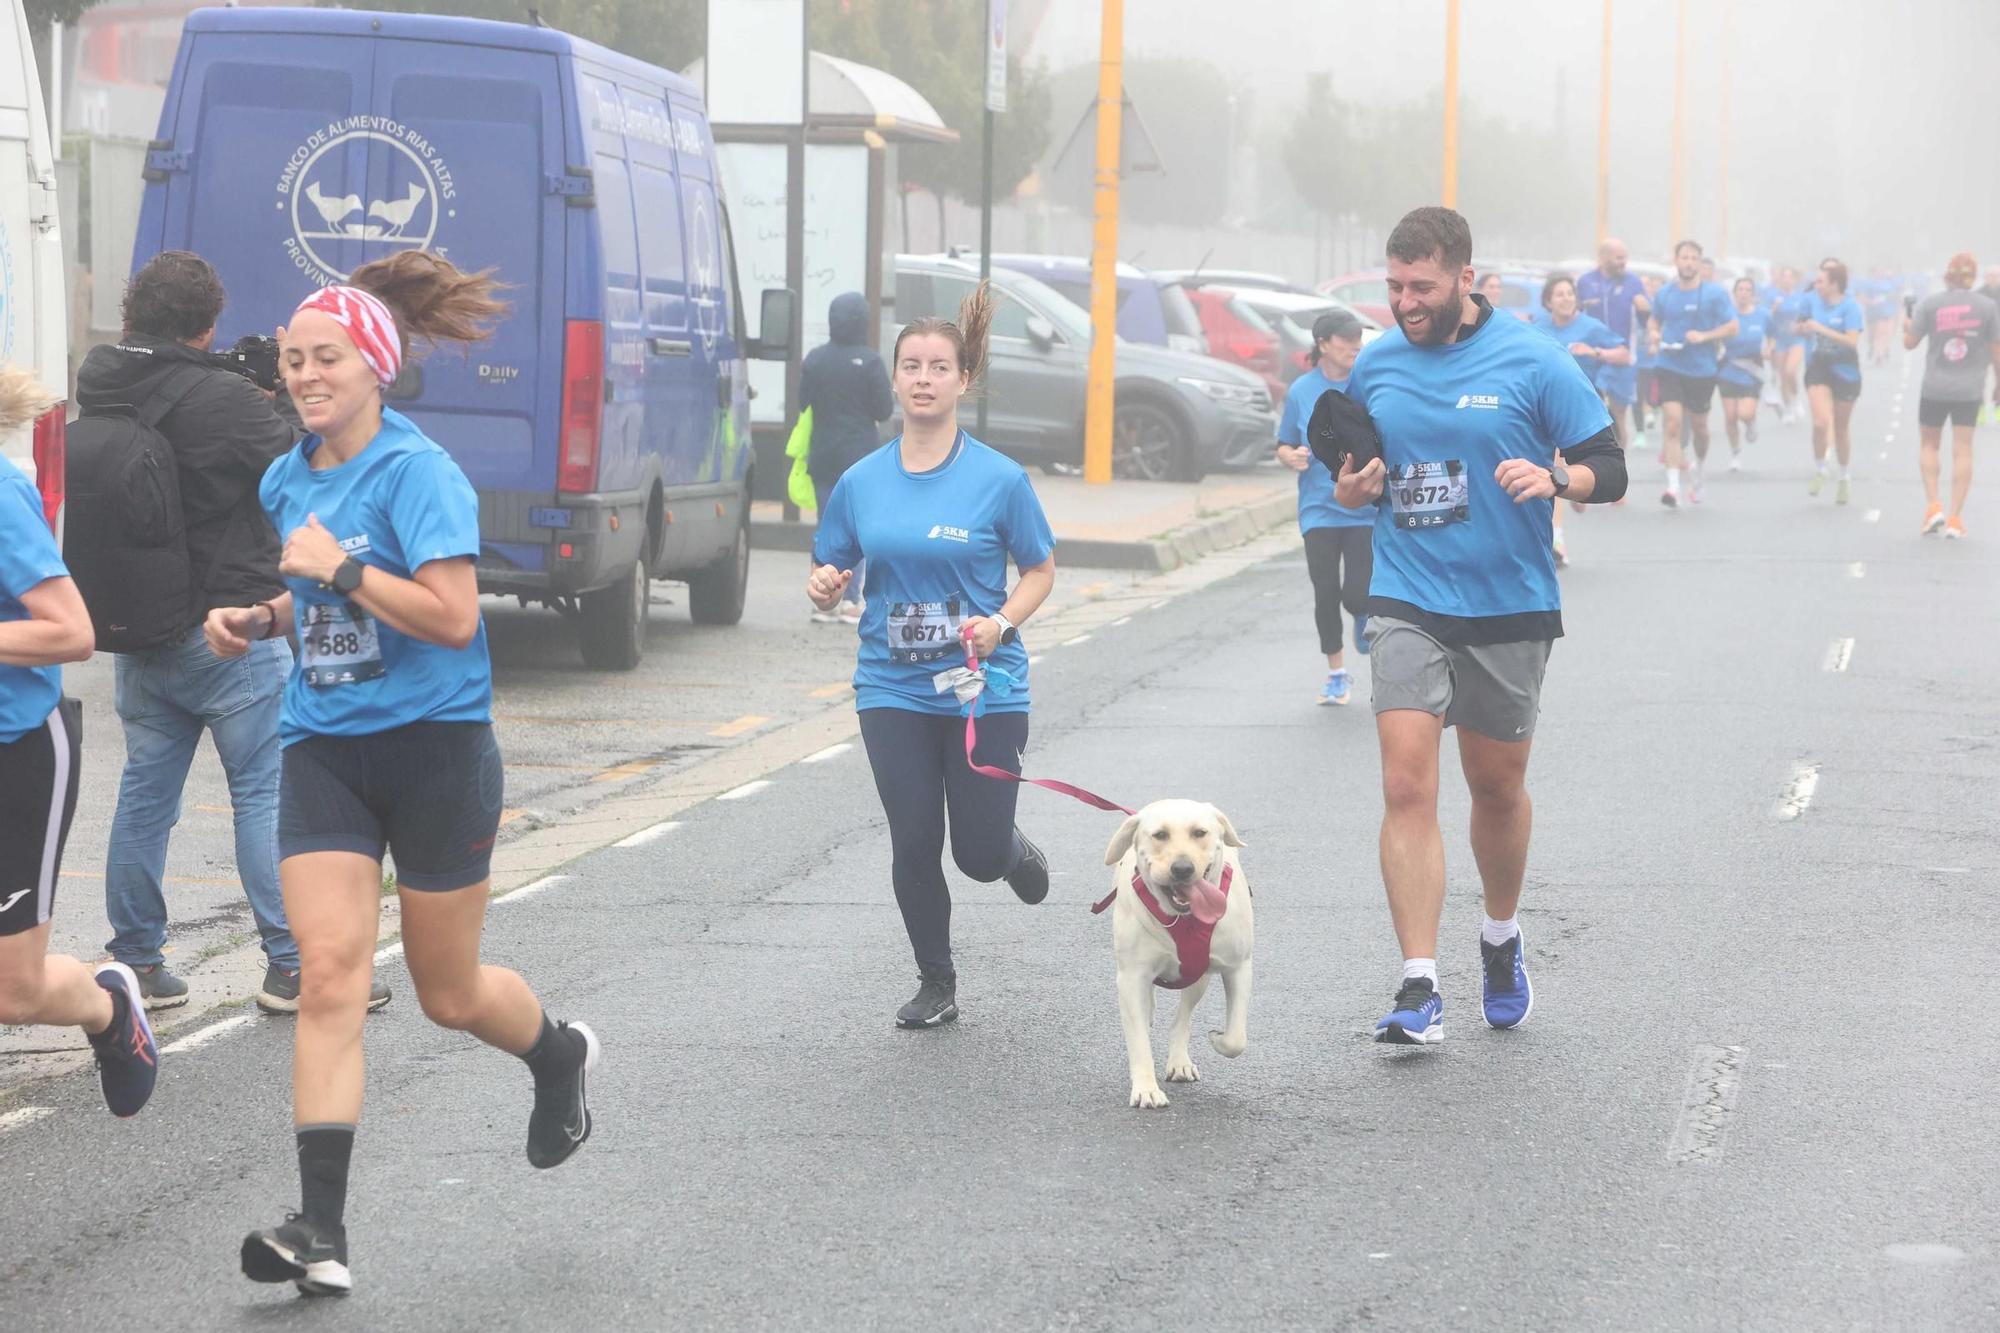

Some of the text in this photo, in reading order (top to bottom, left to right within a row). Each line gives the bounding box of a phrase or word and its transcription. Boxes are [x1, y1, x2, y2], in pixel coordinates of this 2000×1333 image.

[276, 115, 456, 200] BANCO DE ALIMENTOS RIAS ALTAS
[478, 364, 518, 379] Daily
[1472, 395, 1499, 404] 5KM
[1418, 462, 1442, 472] 5KM
[1400, 485, 1450, 506] 0672
[943, 526, 969, 538] 5KM
[918, 602, 942, 610] 5KM
[901, 625, 949, 642] 0671
